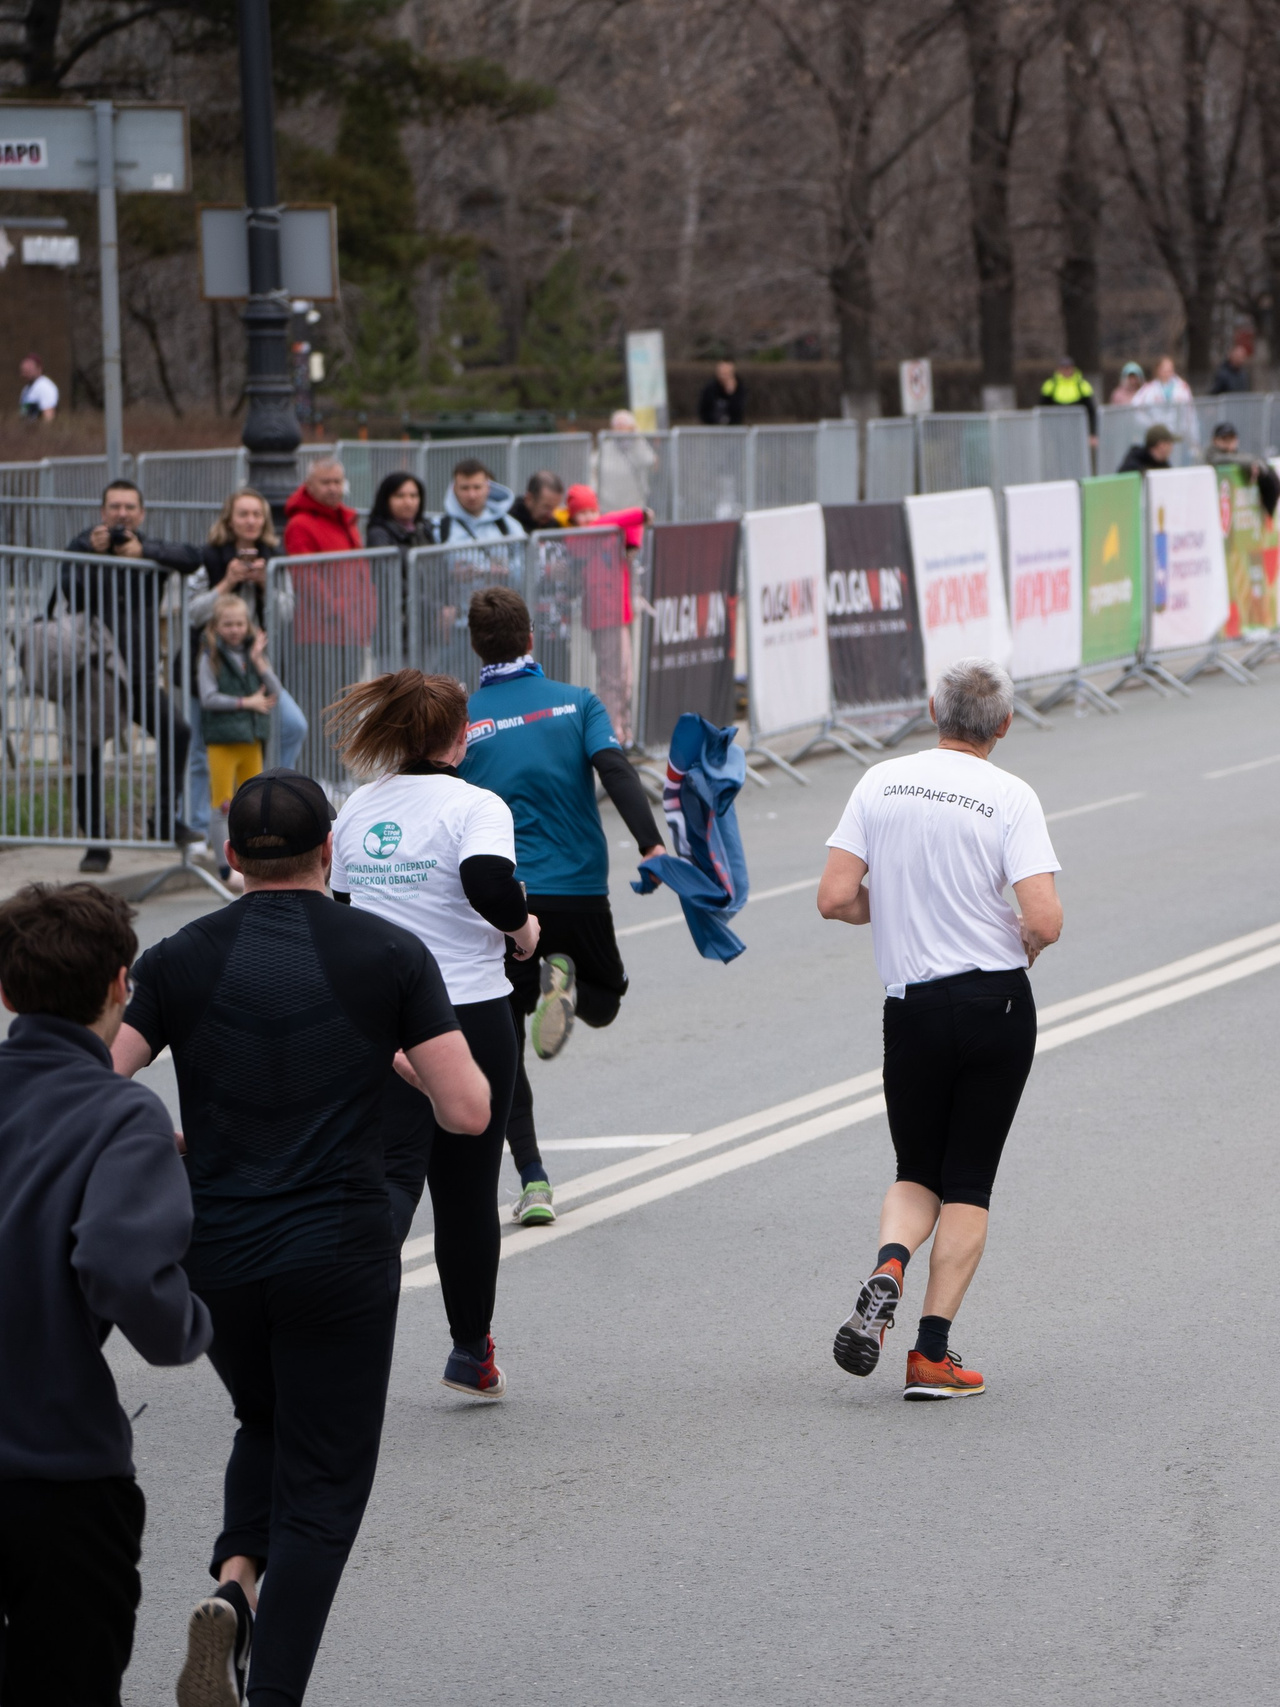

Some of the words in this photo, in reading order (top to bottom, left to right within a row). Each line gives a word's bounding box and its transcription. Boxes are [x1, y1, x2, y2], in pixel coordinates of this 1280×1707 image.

[0, 144, 42, 164] АРО
[883, 784, 995, 818] САМАРАНЕФТЕГАЗ
[383, 829, 401, 837] СТРОЙ
[394, 860, 438, 873] ОПЕРАТОР
[388, 872, 428, 885] ОБЛАСТИ
[275, 891, 297, 899] PRO
